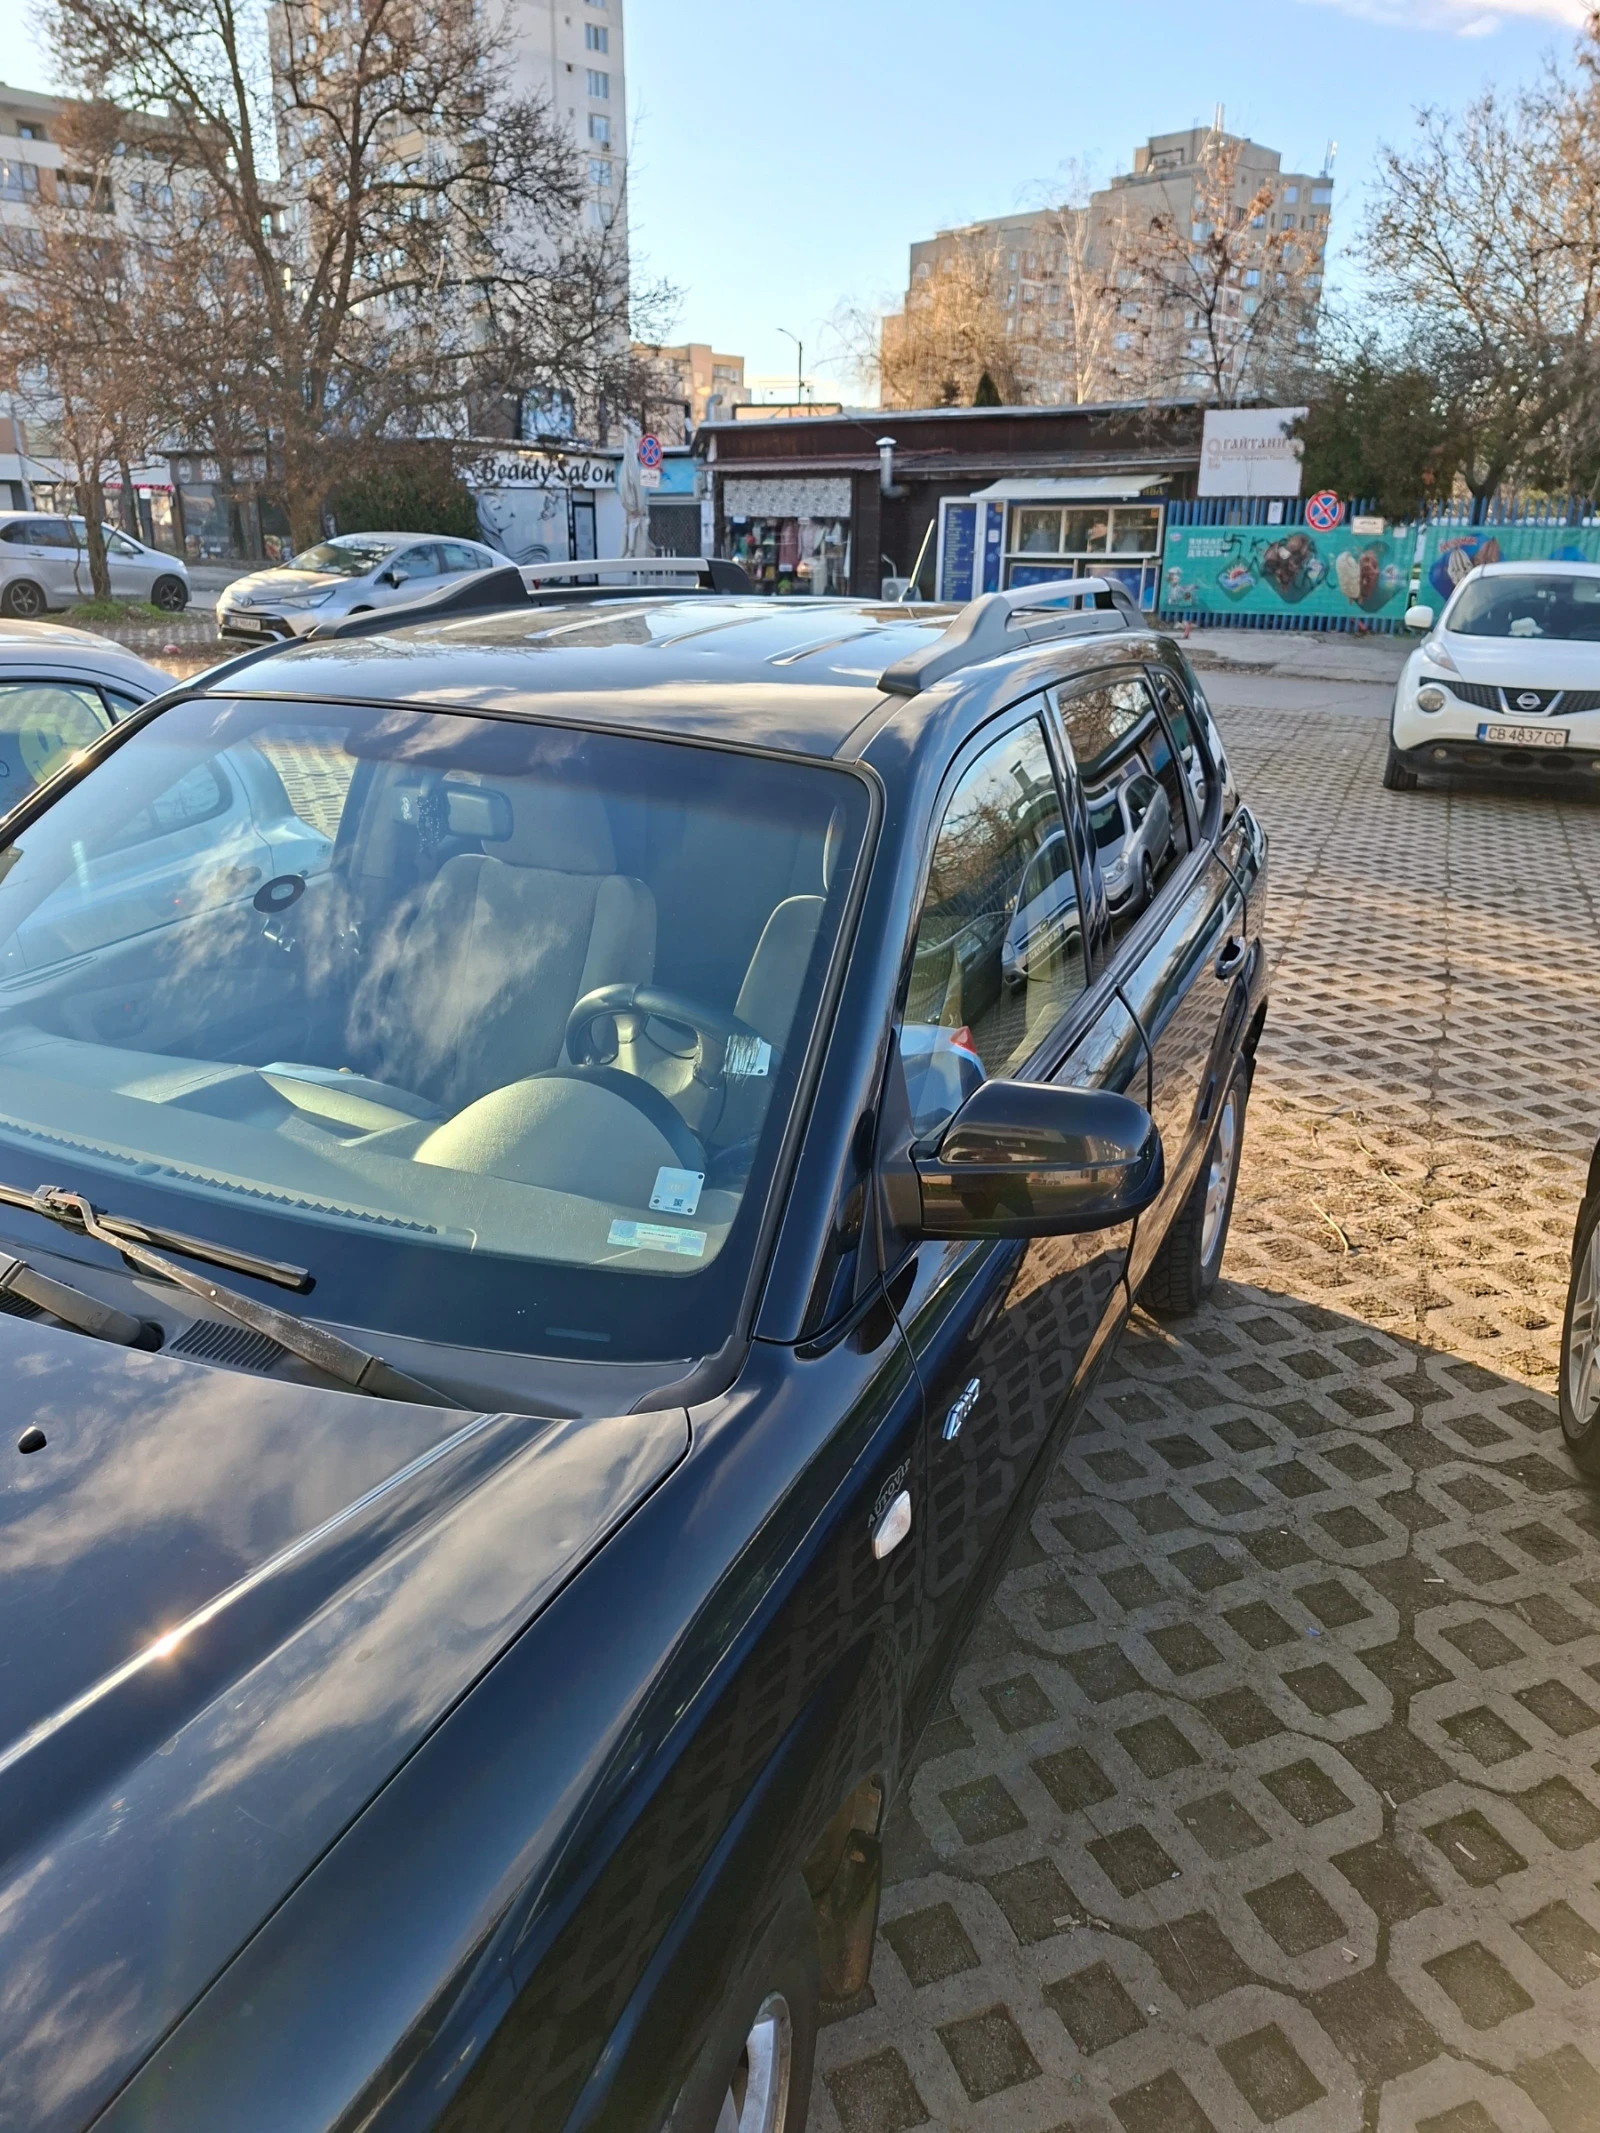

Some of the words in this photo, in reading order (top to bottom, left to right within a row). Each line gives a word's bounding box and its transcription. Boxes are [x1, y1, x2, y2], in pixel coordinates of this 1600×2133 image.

[482, 457, 552, 487] Beauty
[558, 457, 616, 483] Salon
[1488, 727, 1506, 741] CB
[1544, 731, 1564, 745] CC
[867, 1458, 911, 1528] AUTOVIP
